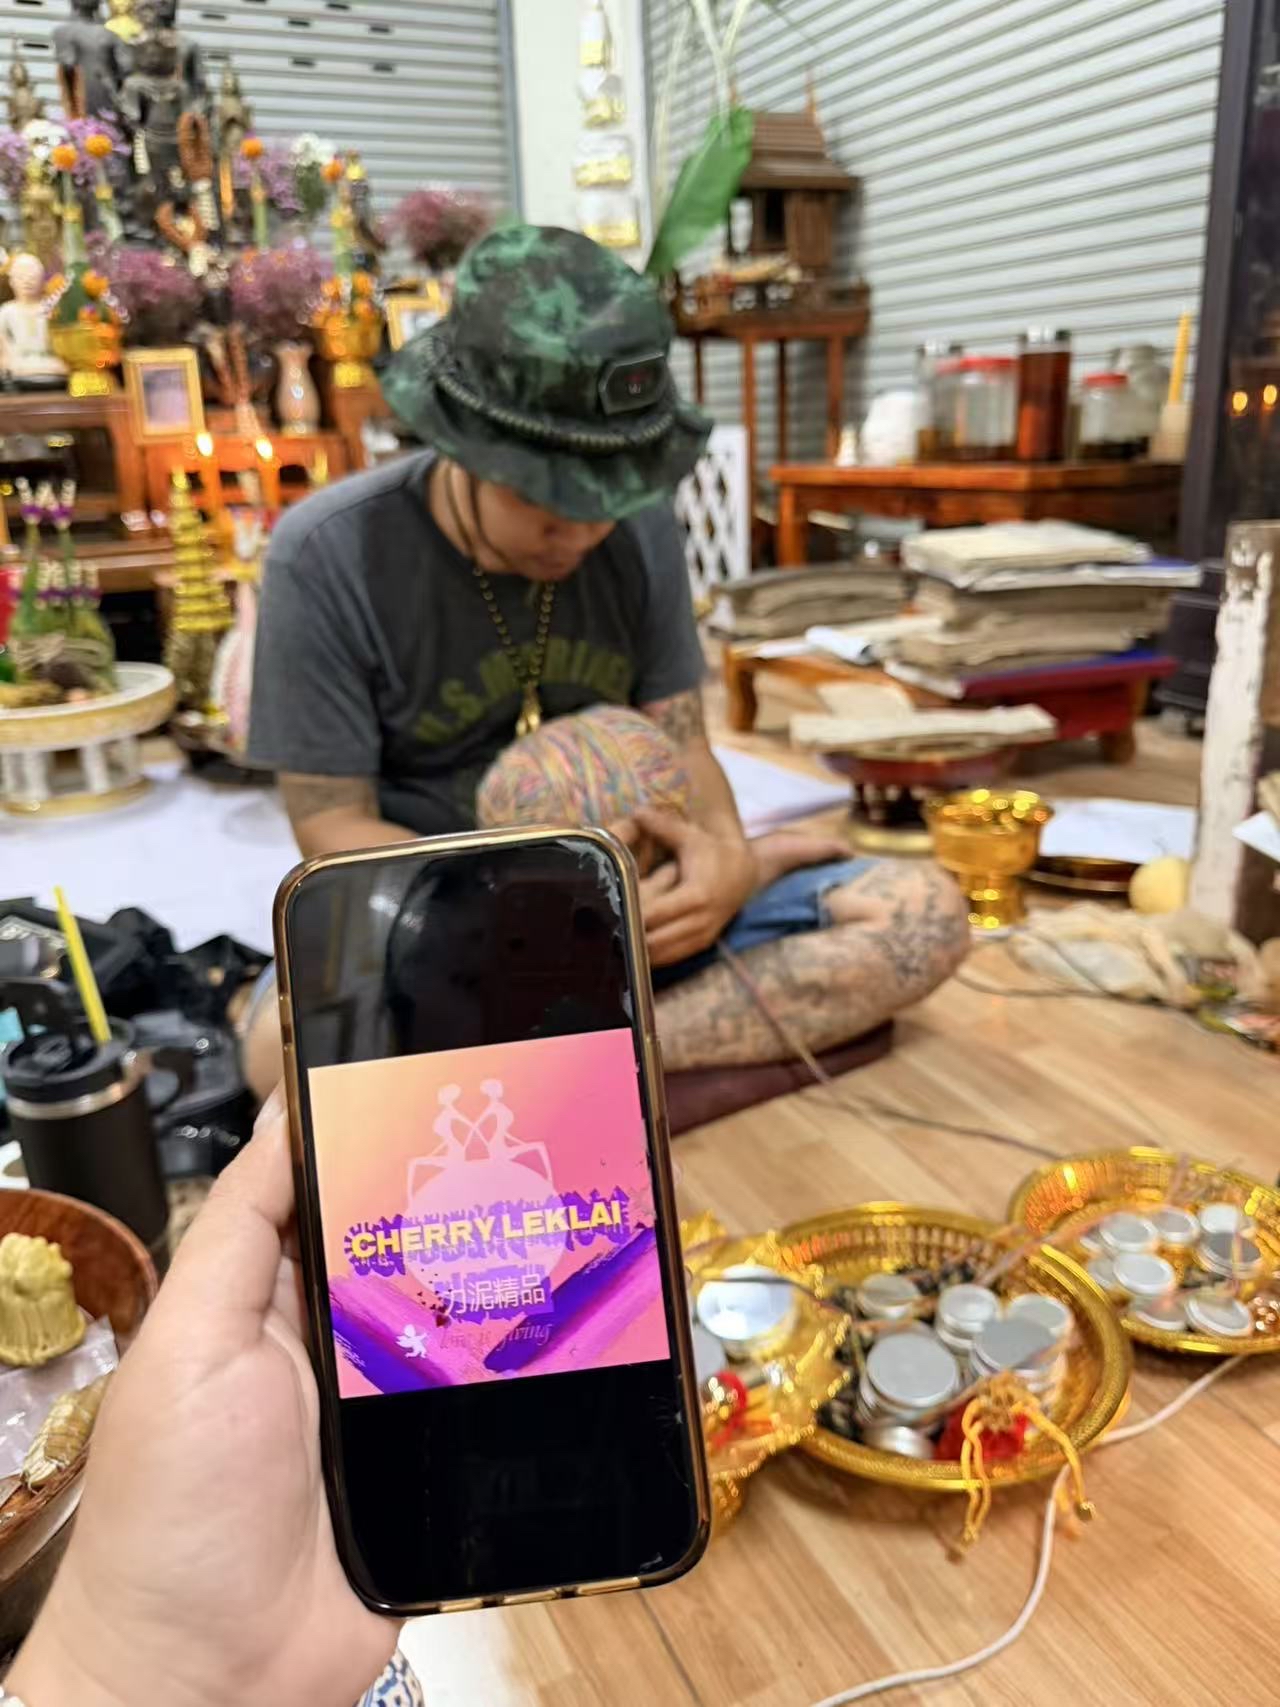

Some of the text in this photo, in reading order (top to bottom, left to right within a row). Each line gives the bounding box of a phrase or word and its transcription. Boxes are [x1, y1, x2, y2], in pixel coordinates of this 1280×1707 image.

[351, 1200, 622, 1258] CHERRY LEKLAI
[443, 1273, 545, 1315] 力泥精品
